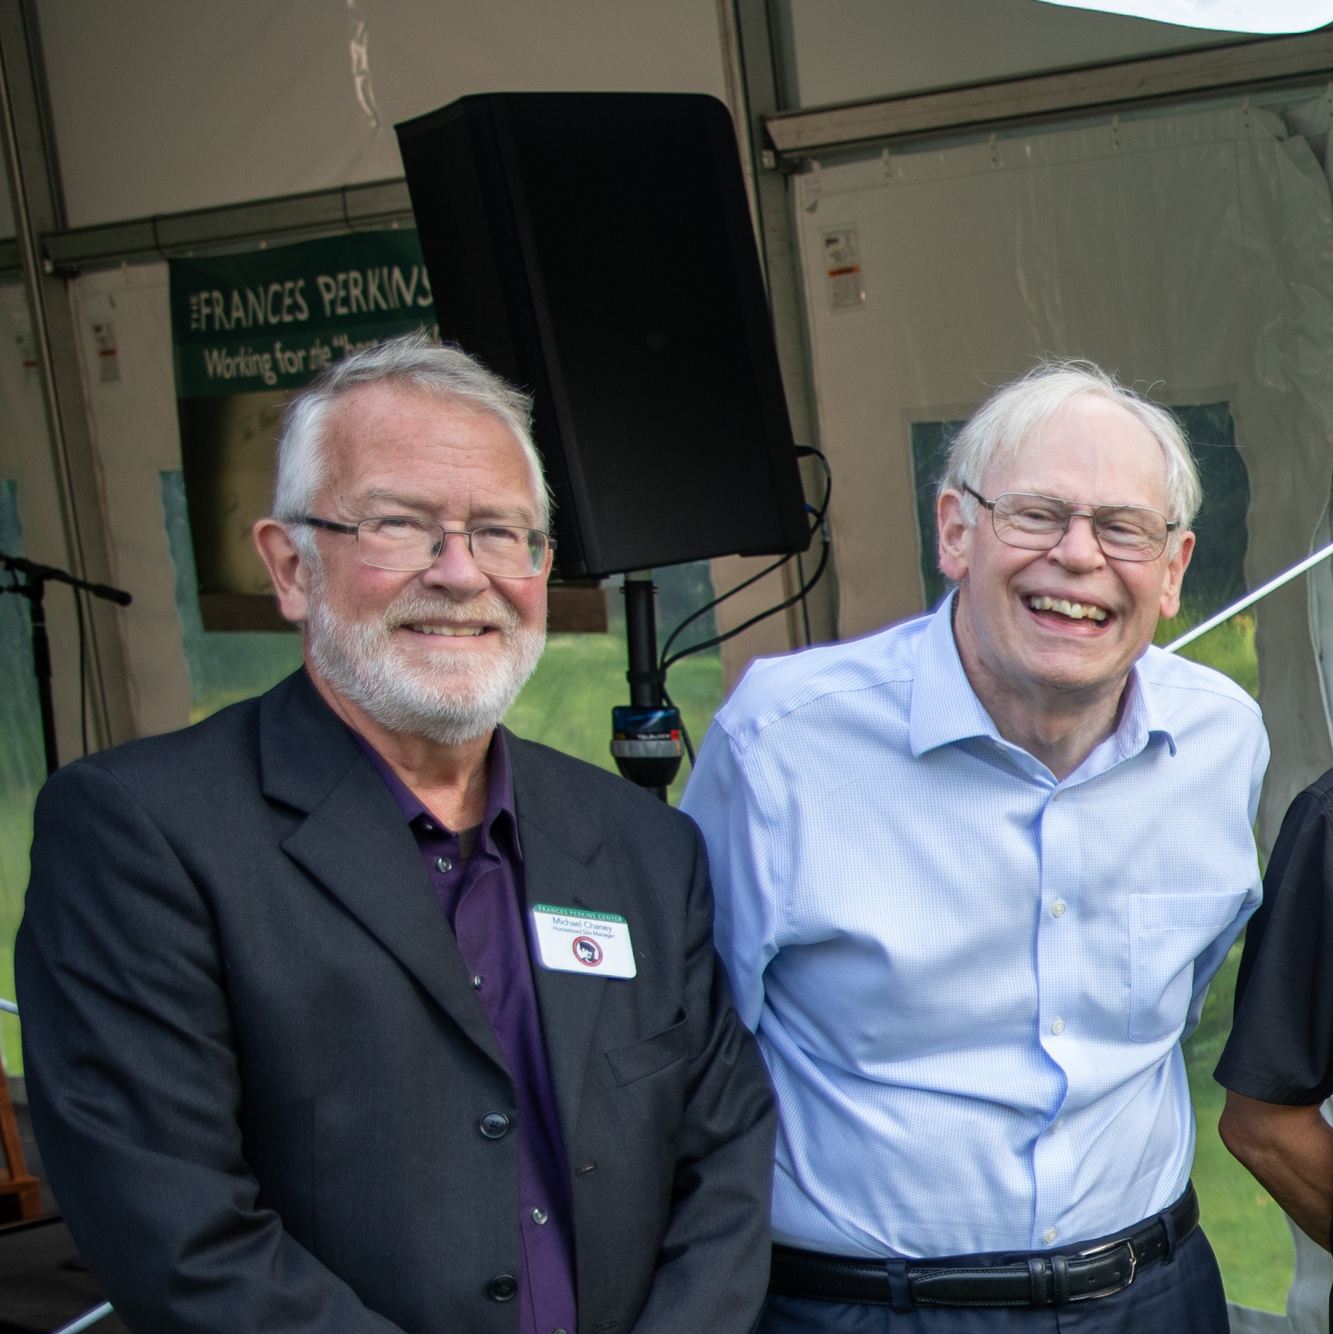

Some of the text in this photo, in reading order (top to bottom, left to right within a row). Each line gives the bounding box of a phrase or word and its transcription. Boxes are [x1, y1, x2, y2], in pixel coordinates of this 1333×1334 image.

[199, 264, 434, 331] FRANCES PERKINS
[203, 345, 277, 385] Working
[274, 341, 306, 374] for
[309, 338, 332, 371] the
[538, 906, 622, 922] FRANCES PERKINS CENTER
[552, 917, 612, 933] Michael Chaney
[552, 926, 582, 935] Homestead
[593, 931, 615, 939] Manager
